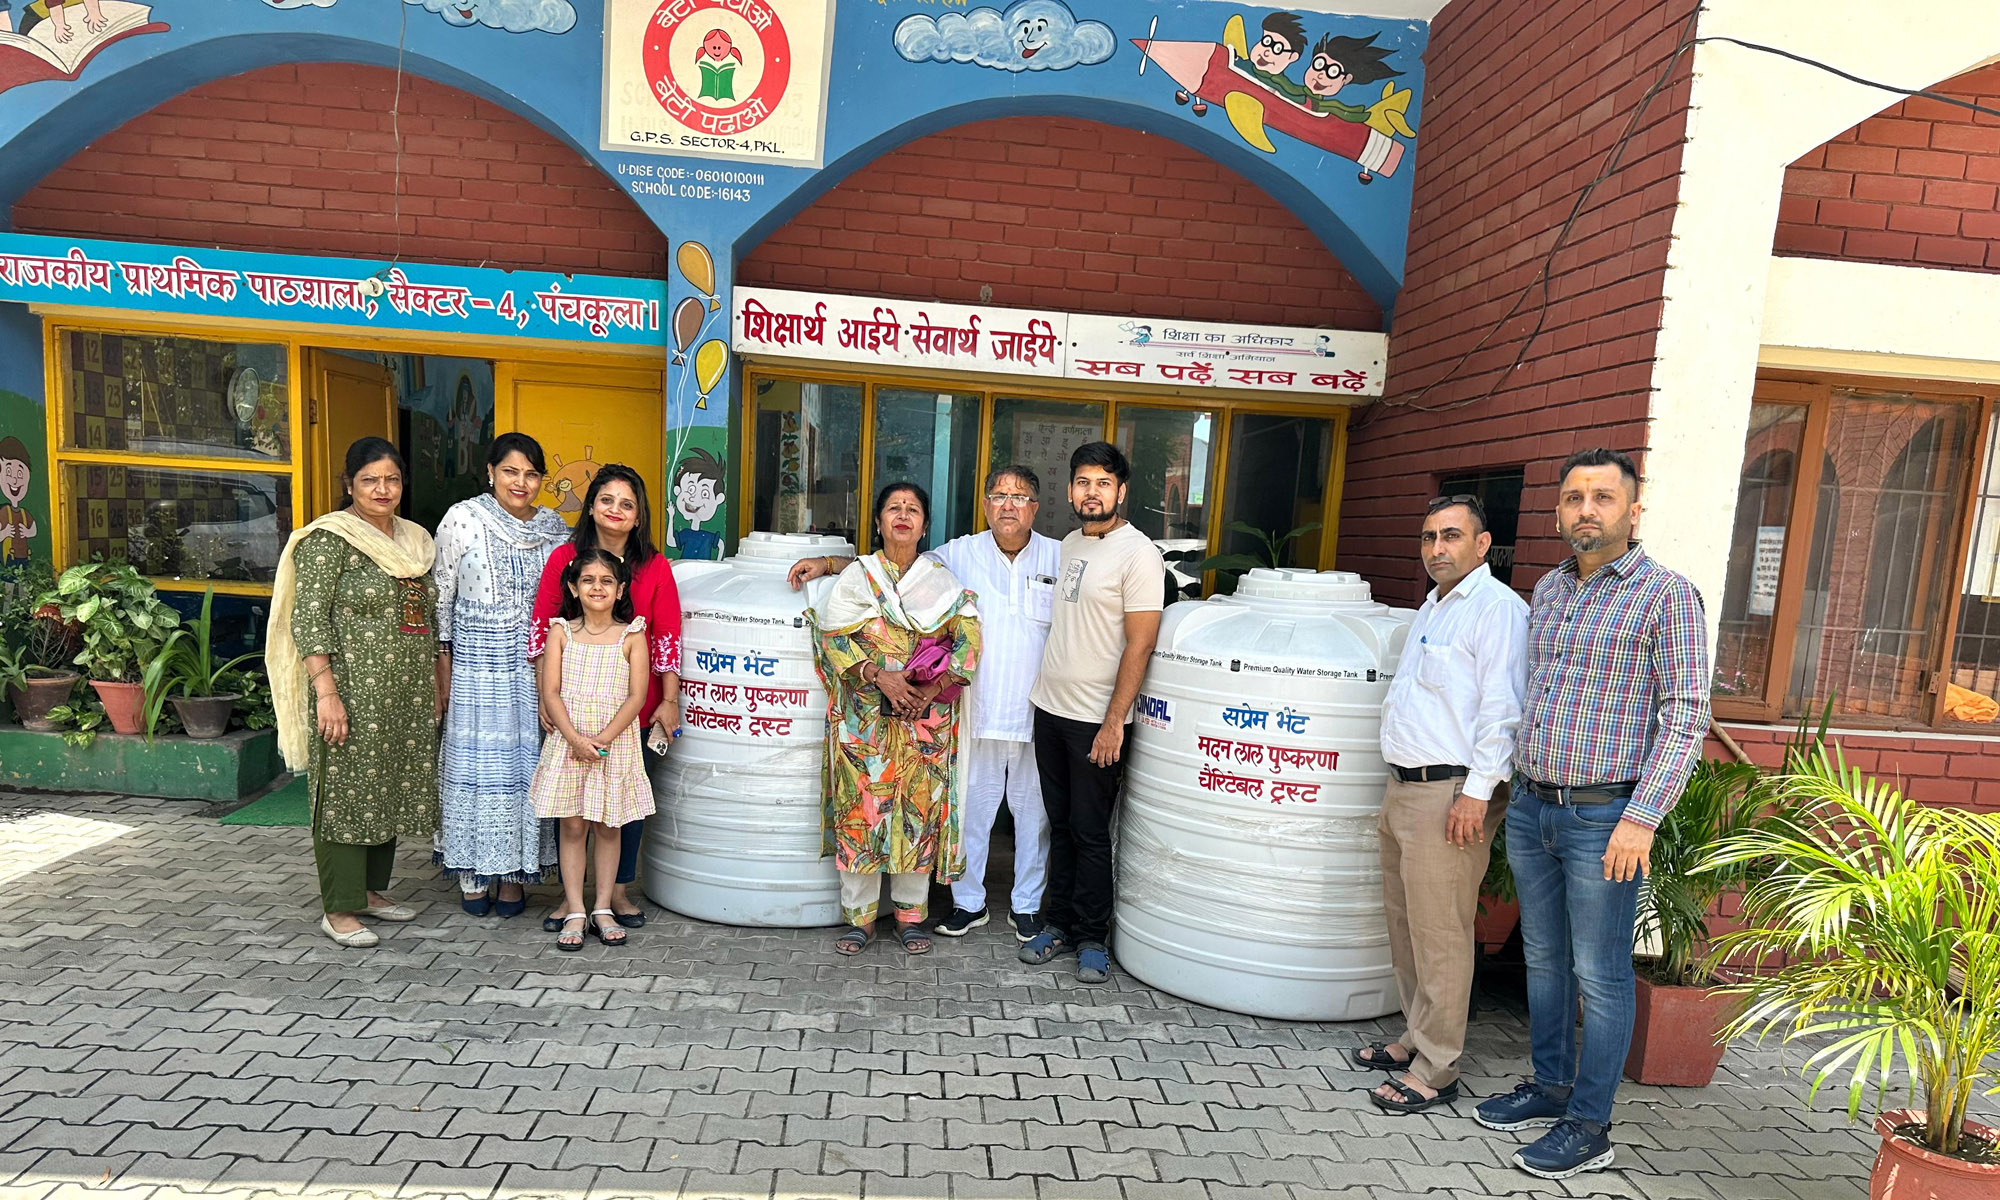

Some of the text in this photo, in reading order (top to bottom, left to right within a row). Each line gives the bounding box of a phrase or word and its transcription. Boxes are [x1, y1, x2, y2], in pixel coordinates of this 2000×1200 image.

[656, 75, 696, 121] बेटी
[630, 131, 674, 145] G.P.S.
[618, 163, 653, 177] U-DISE
[631, 181, 677, 197] SCHOOL
[0, 246, 114, 293] राजकीय
[117, 255, 241, 302] प्राथमिक
[742, 297, 1057, 367] शिक्षार्थ आईये सेवार्थ जाईये
[1162, 327, 1294, 348] शिक्षा का अधिकार
[86, 338, 99, 363] 12
[1198, 352, 1225, 360] शिक्षा
[1229, 353, 1276, 363] अभियान
[1074, 359, 1145, 377] सब
[1228, 368, 1297, 386] सब
[106, 384, 121, 408] 23
[88, 425, 102, 447] 14
[110, 467, 123, 488] 25
[91, 507, 104, 529] 16
[714, 612, 732, 622] Quality
[732, 615, 748, 623] Water
[749, 616, 770, 625] Storage
[772, 617, 785, 625] Tank
[696, 647, 779, 676] सप्रेम भेंट
[1189, 655, 1209, 666] Storage
[1209, 658, 1223, 667] Tank
[1243, 663, 1358, 680] Premium Quality Water Storage Tank
[679, 678, 809, 713] मदन लाल पुष्करणा
[749, 716, 793, 737] ट्रस्ट
[1222, 702, 1311, 734] सप्रेम भेंट
[1198, 735, 1340, 774] मदन लाल पुष्करणा
[1270, 780, 1321, 804] ट्रस्ट
